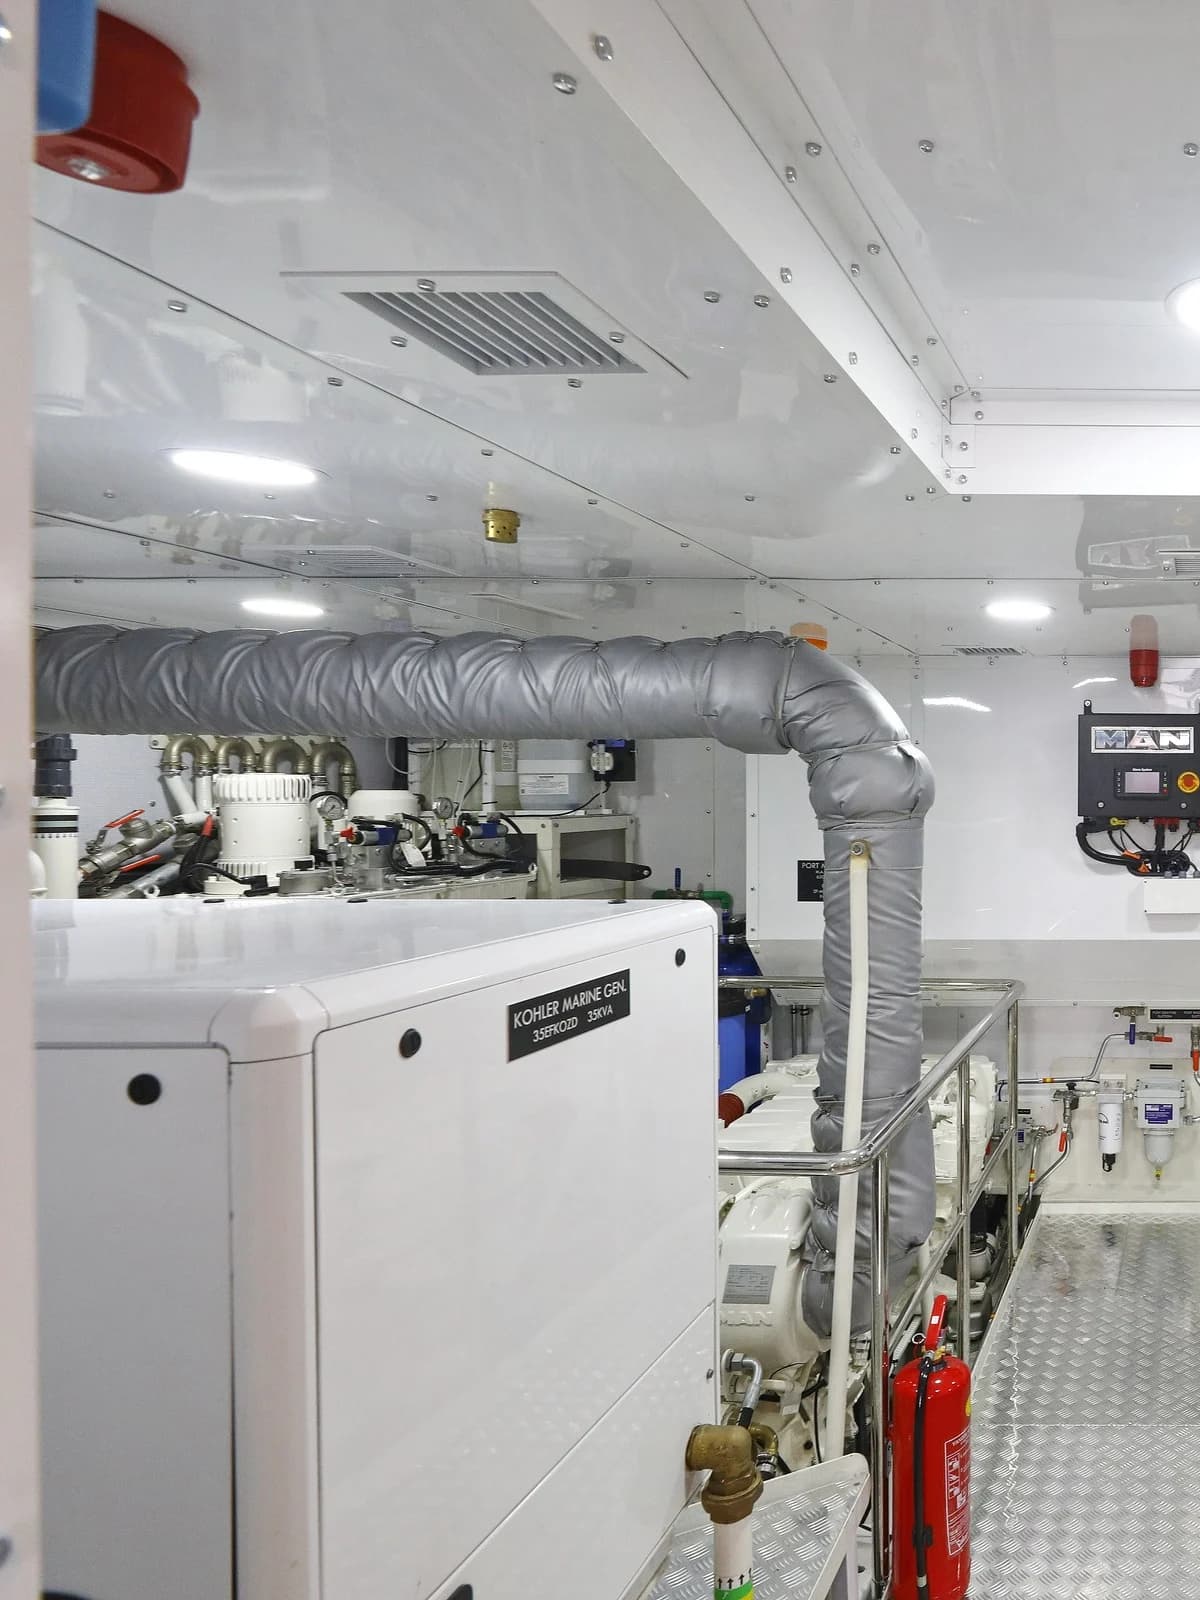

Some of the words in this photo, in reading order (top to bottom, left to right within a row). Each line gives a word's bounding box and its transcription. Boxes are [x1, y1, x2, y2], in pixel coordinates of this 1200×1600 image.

[1095, 729, 1190, 749] MAN
[513, 1000, 559, 1029] KOHLER
[562, 986, 602, 1013] MARINE
[603, 979, 627, 999] GEN.
[532, 1016, 578, 1042] 35EFKOZD
[587, 1004, 613, 1023] 35KVA
